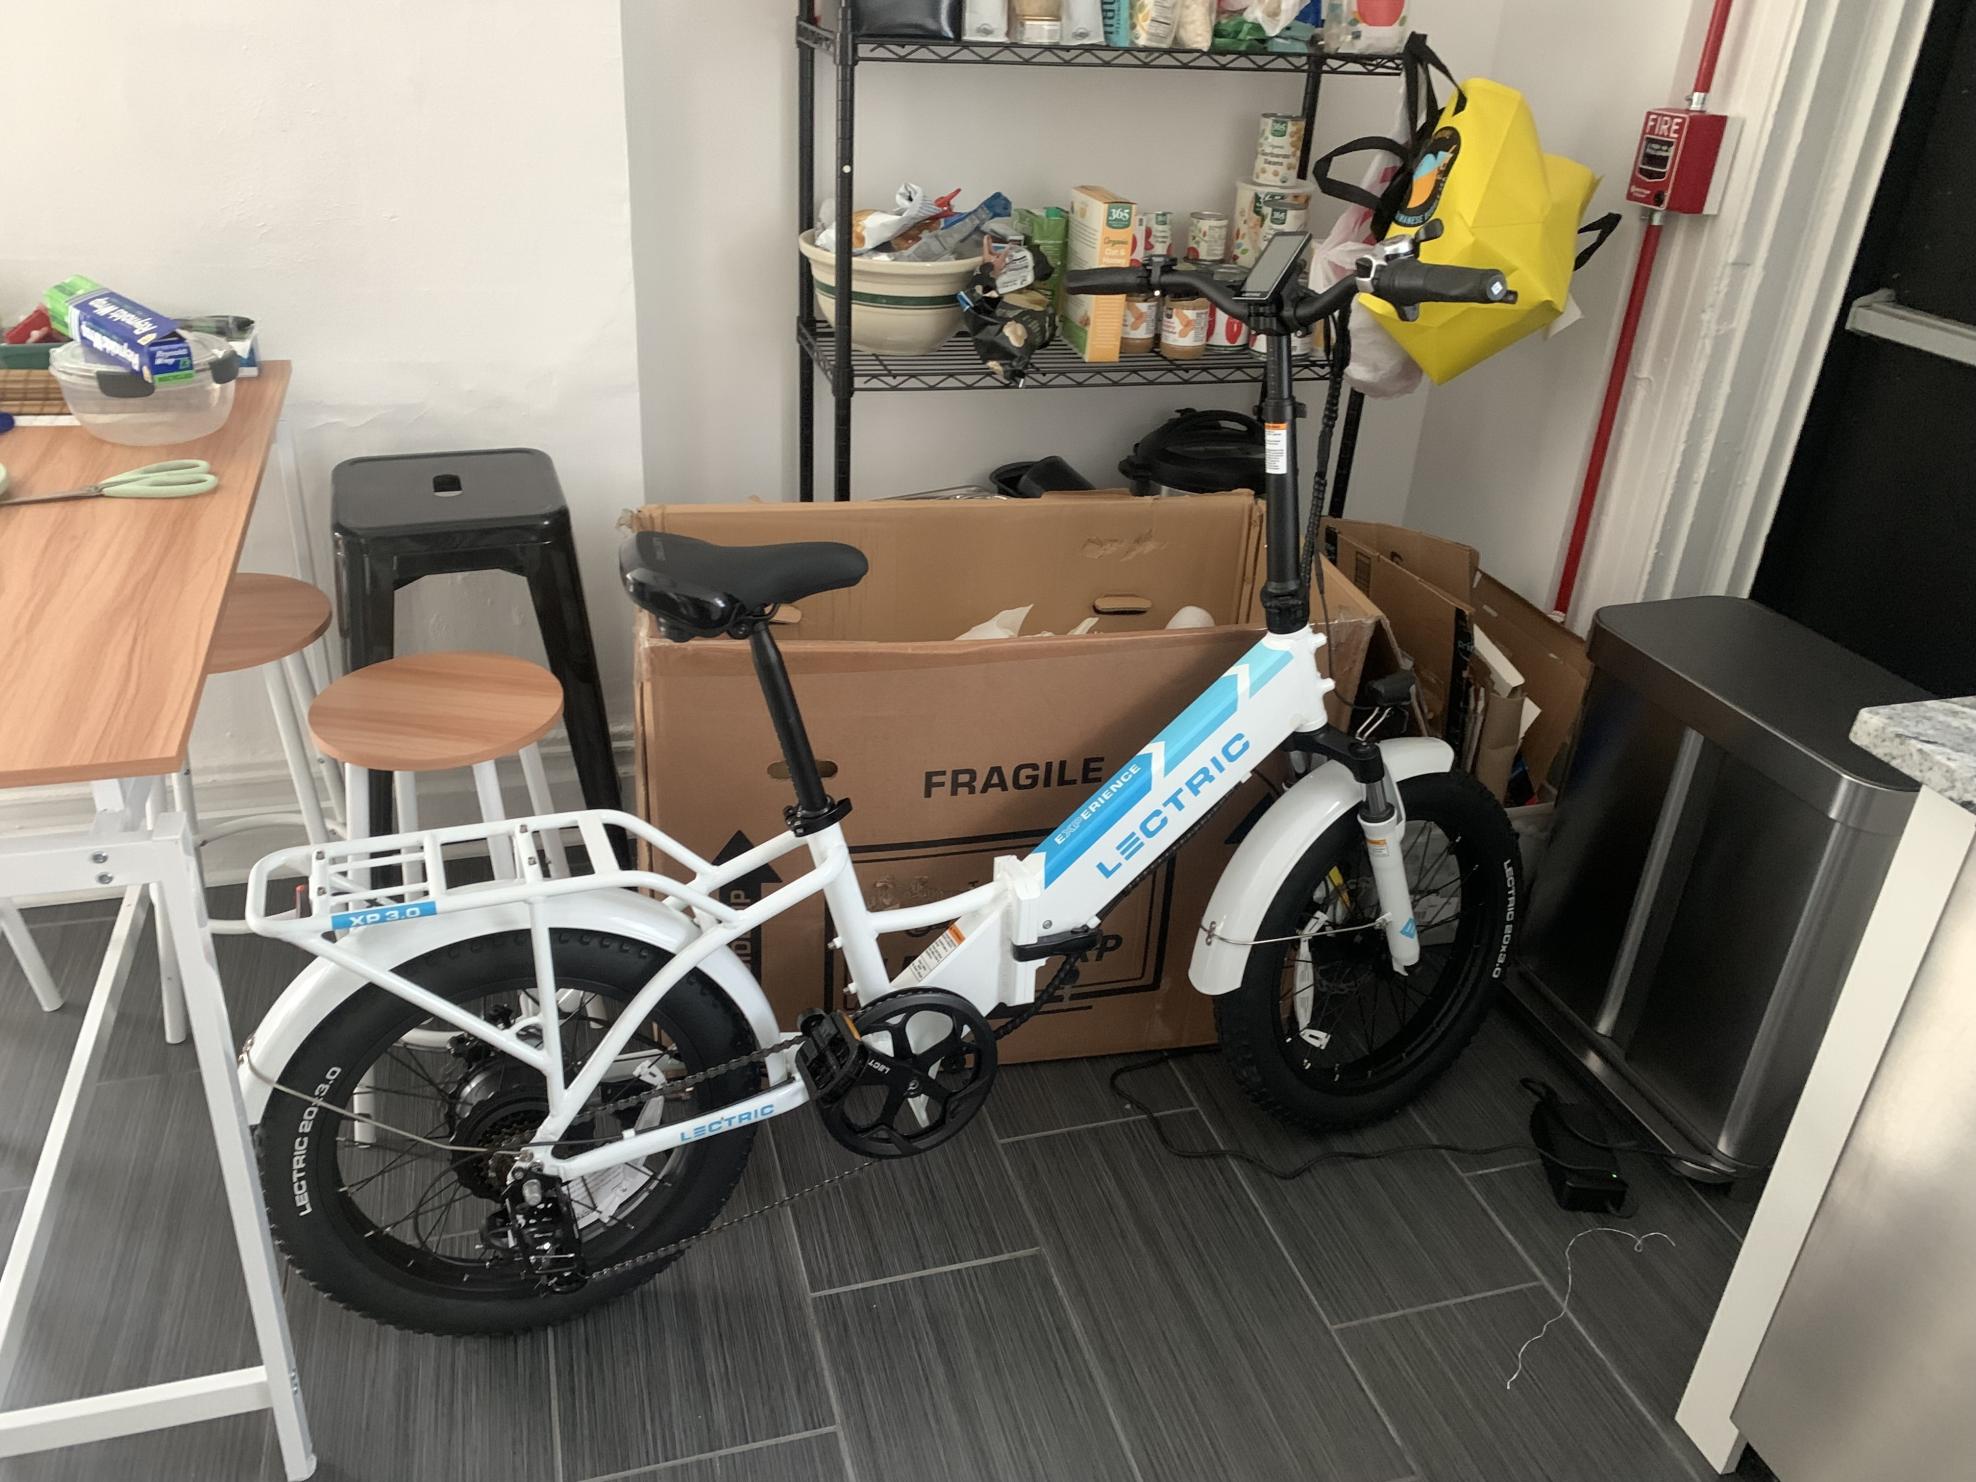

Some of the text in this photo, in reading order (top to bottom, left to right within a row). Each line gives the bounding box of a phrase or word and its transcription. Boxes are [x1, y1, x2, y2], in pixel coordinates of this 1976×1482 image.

[1646, 114, 1682, 138] FIRE
[1108, 208, 1130, 221] 365
[924, 757, 1105, 799] FRAGILE
[1054, 763, 1142, 845] EXPERIENCE
[1096, 732, 1250, 879] LECTRIC
[1503, 858, 1516, 922] LECTRIC
[349, 907, 421, 927] XP 3.0
[868, 1058, 891, 1075] LECT
[680, 1103, 775, 1142] LECTRIC
[292, 1136, 313, 1217] LECTRIC
